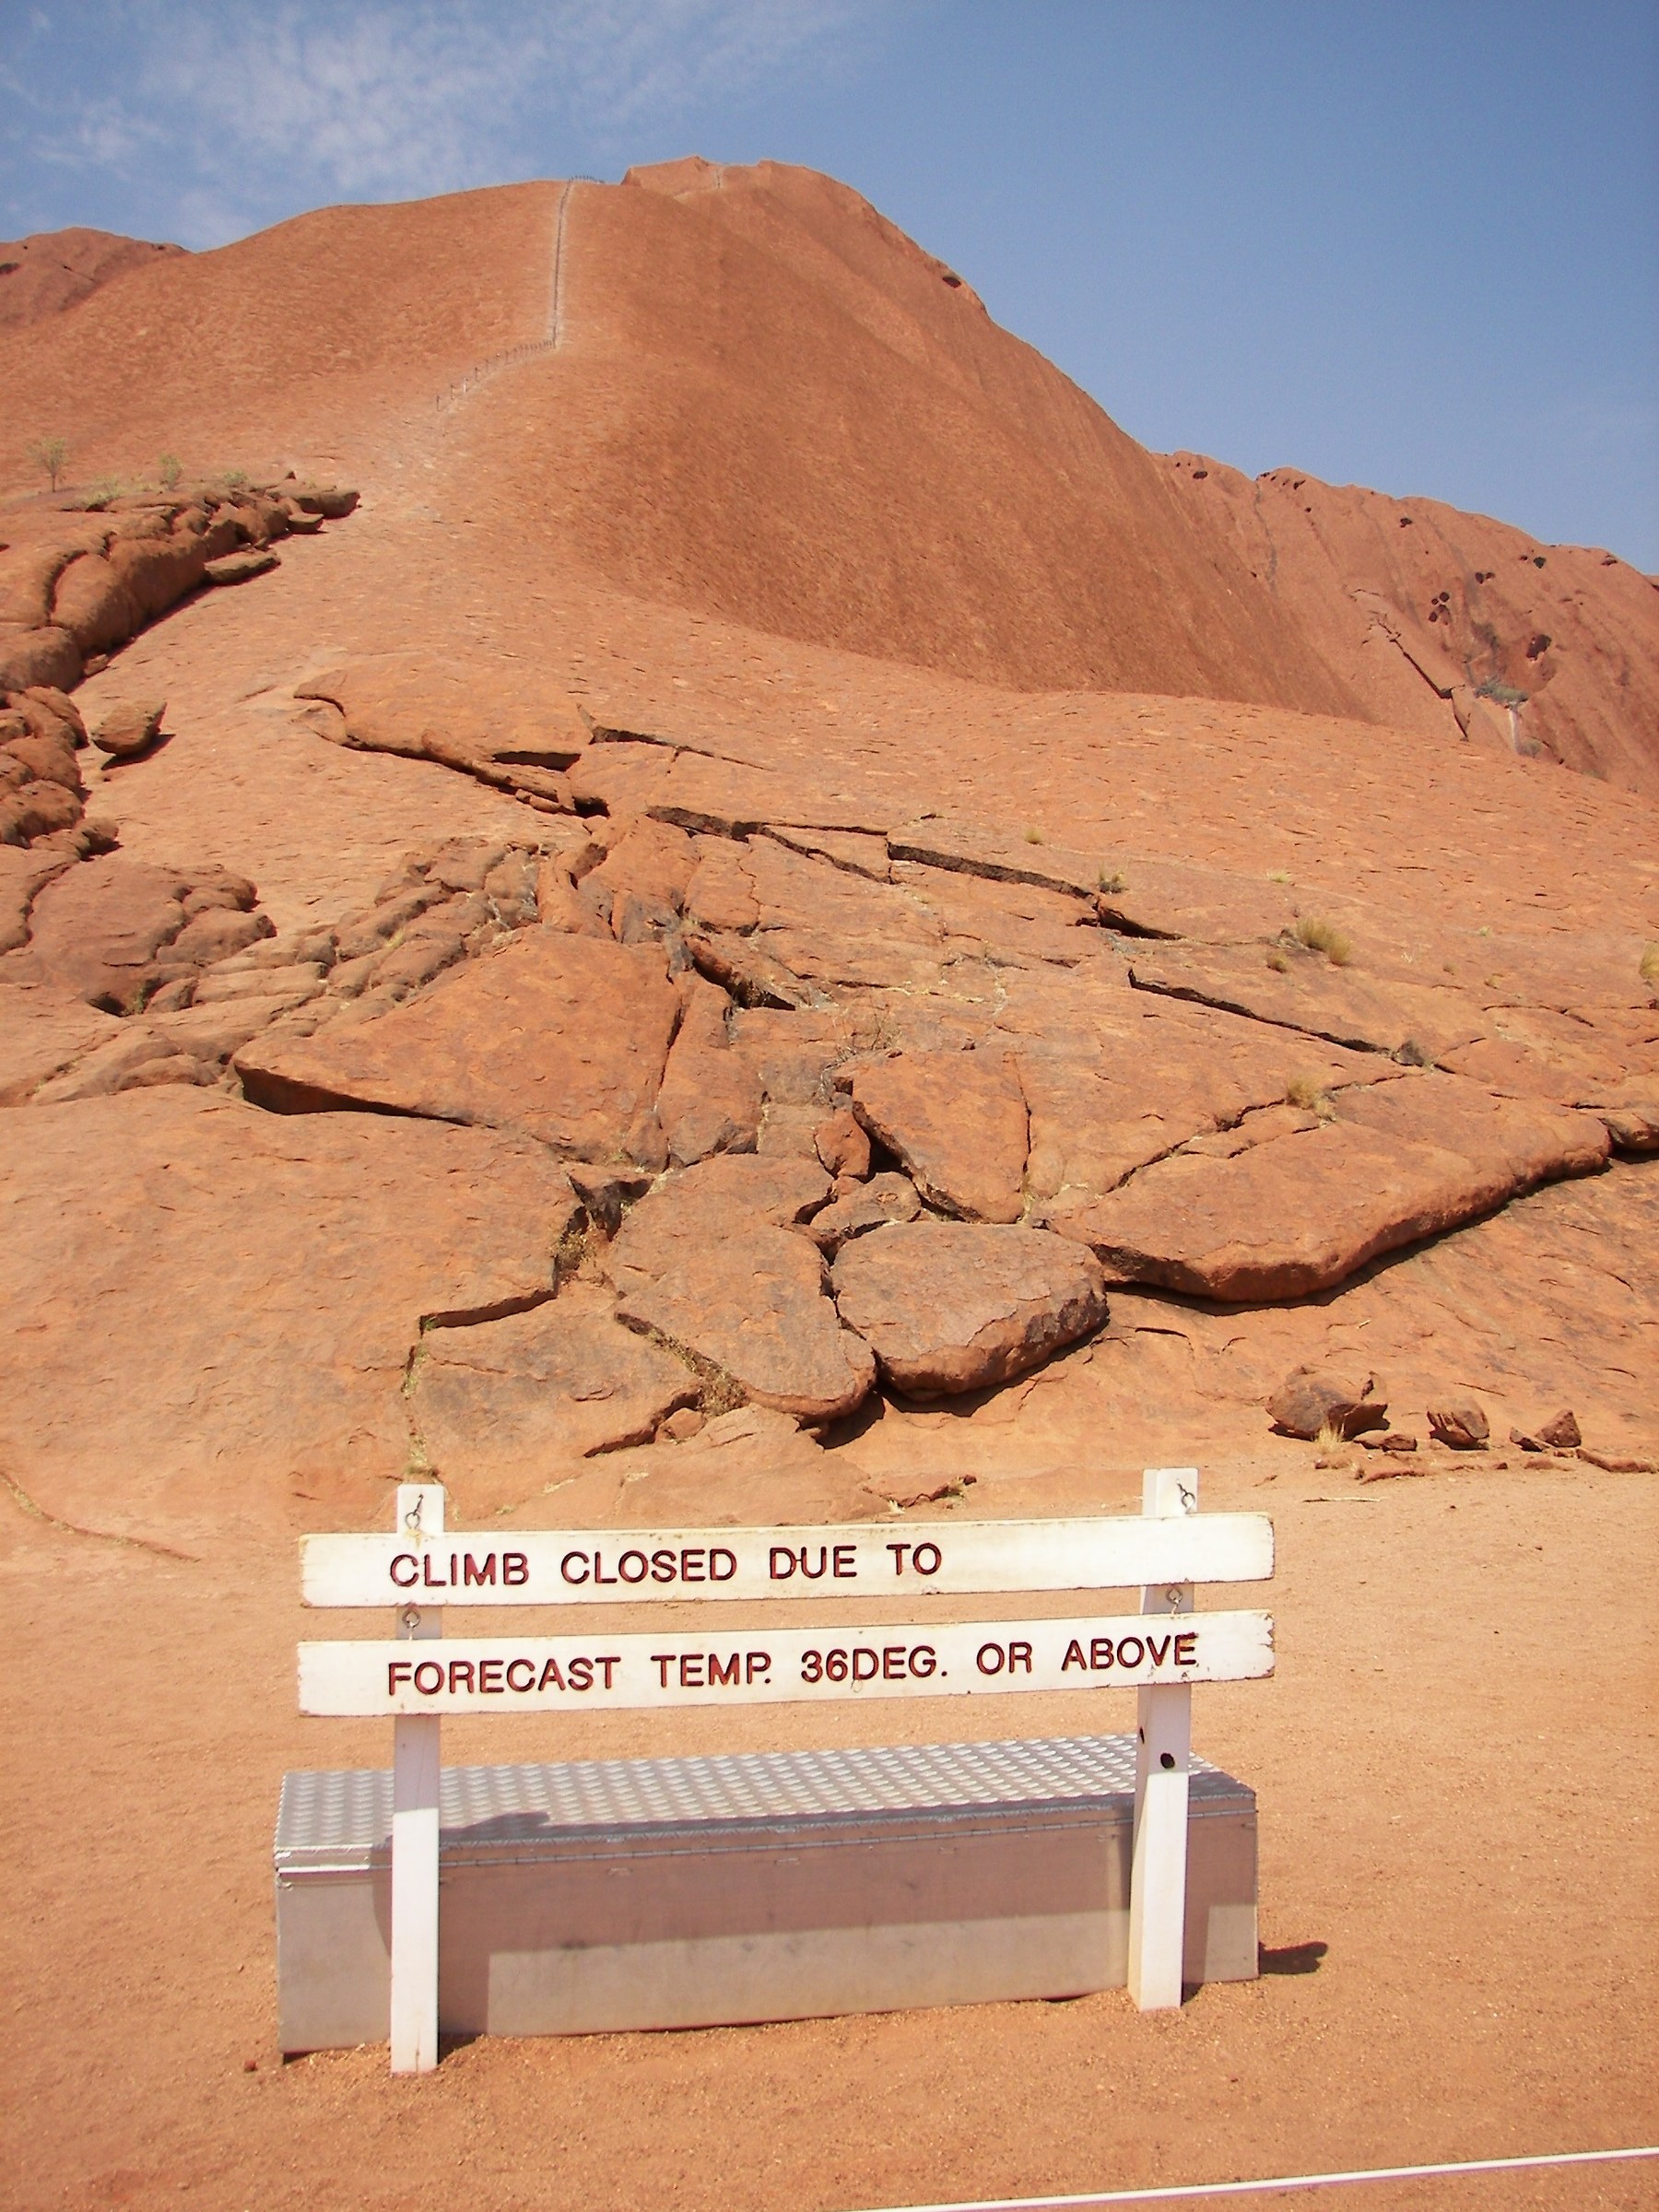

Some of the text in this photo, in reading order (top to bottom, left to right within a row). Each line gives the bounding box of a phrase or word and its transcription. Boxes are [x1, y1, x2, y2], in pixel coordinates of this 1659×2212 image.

[389, 1542, 943, 1588] CLIMB CLOSED DUE TO
[388, 1631, 1200, 1696] FORECAST TEMP. 36DEG. OR ABOVE
